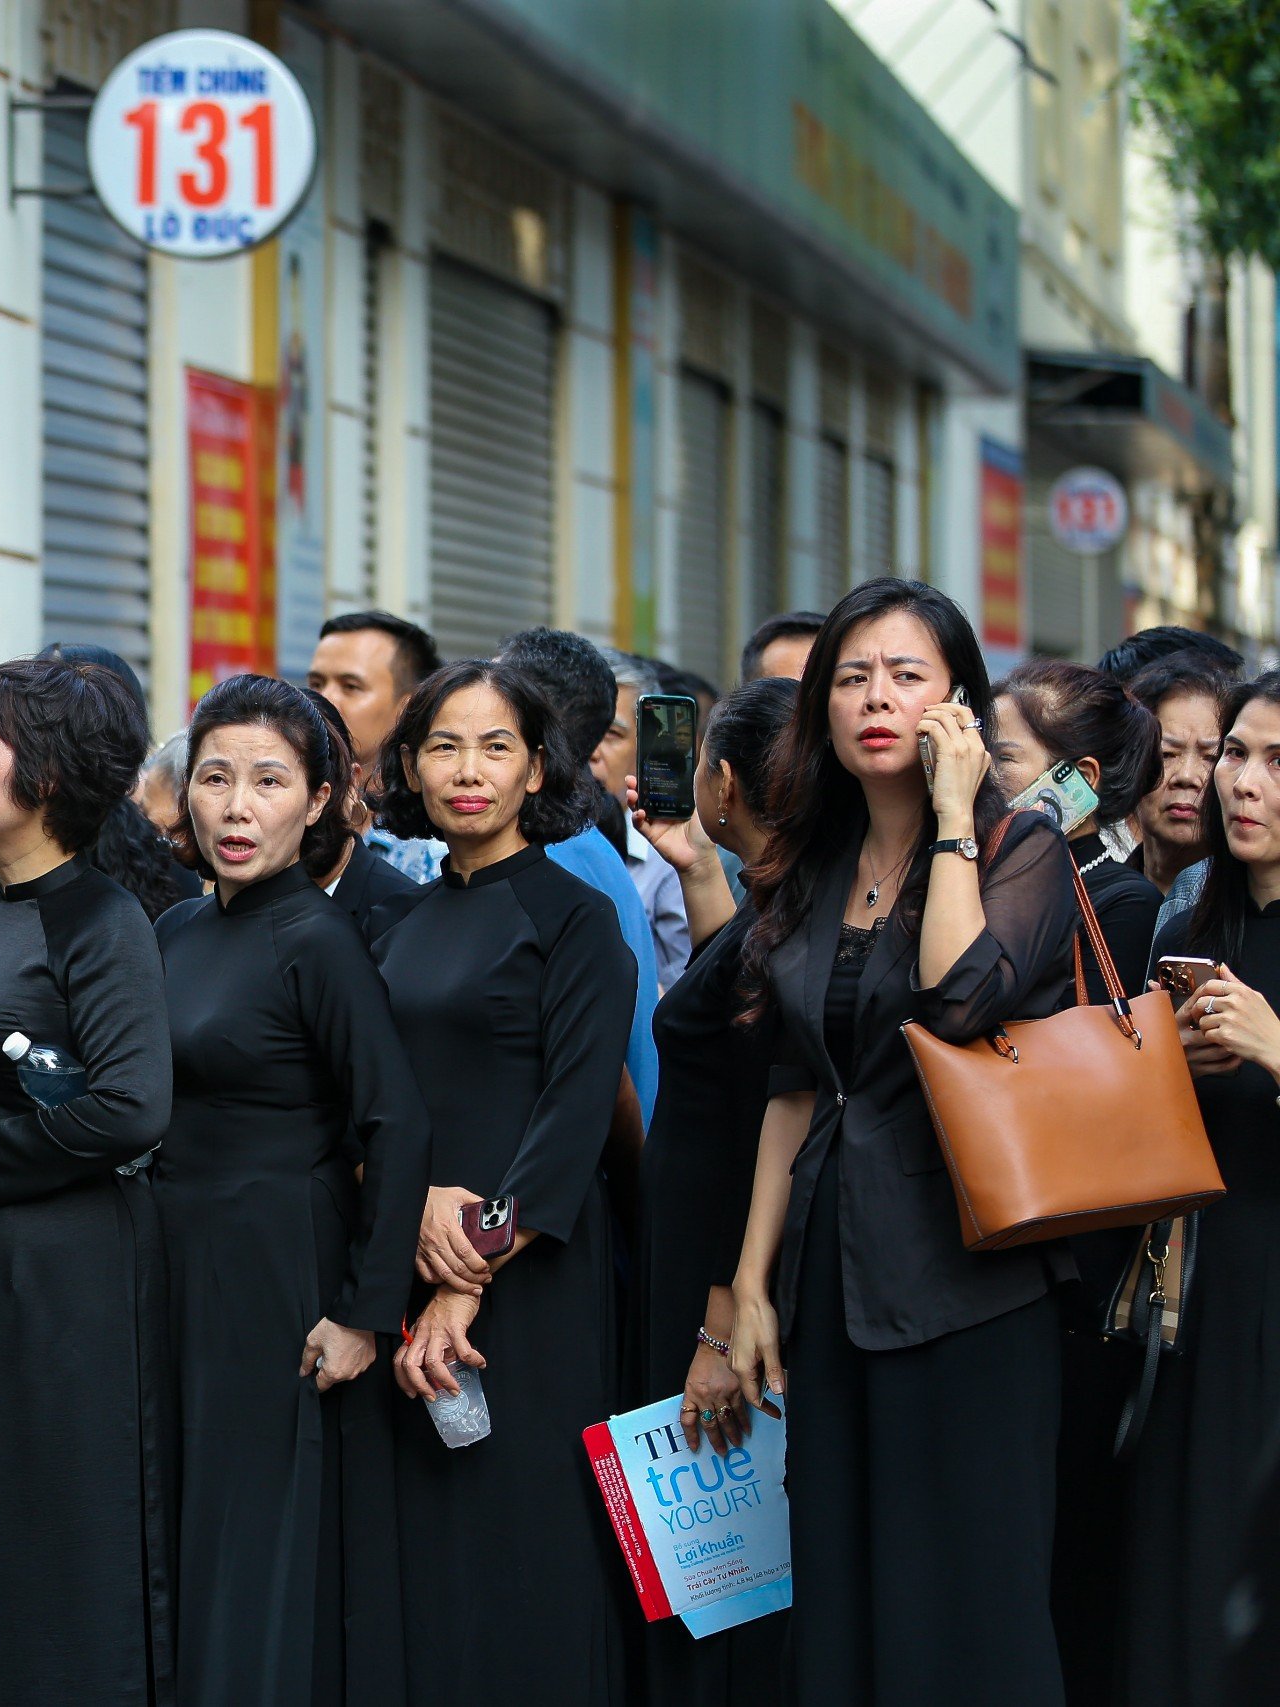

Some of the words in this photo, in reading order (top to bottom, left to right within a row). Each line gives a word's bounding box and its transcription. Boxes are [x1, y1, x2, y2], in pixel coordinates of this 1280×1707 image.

[123, 101, 274, 208] 131
[646, 1447, 755, 1507] true
[659, 1479, 762, 1535] YOGURT
[676, 1547, 697, 1564] Lợi
[698, 1532, 744, 1556] Khuẩn
